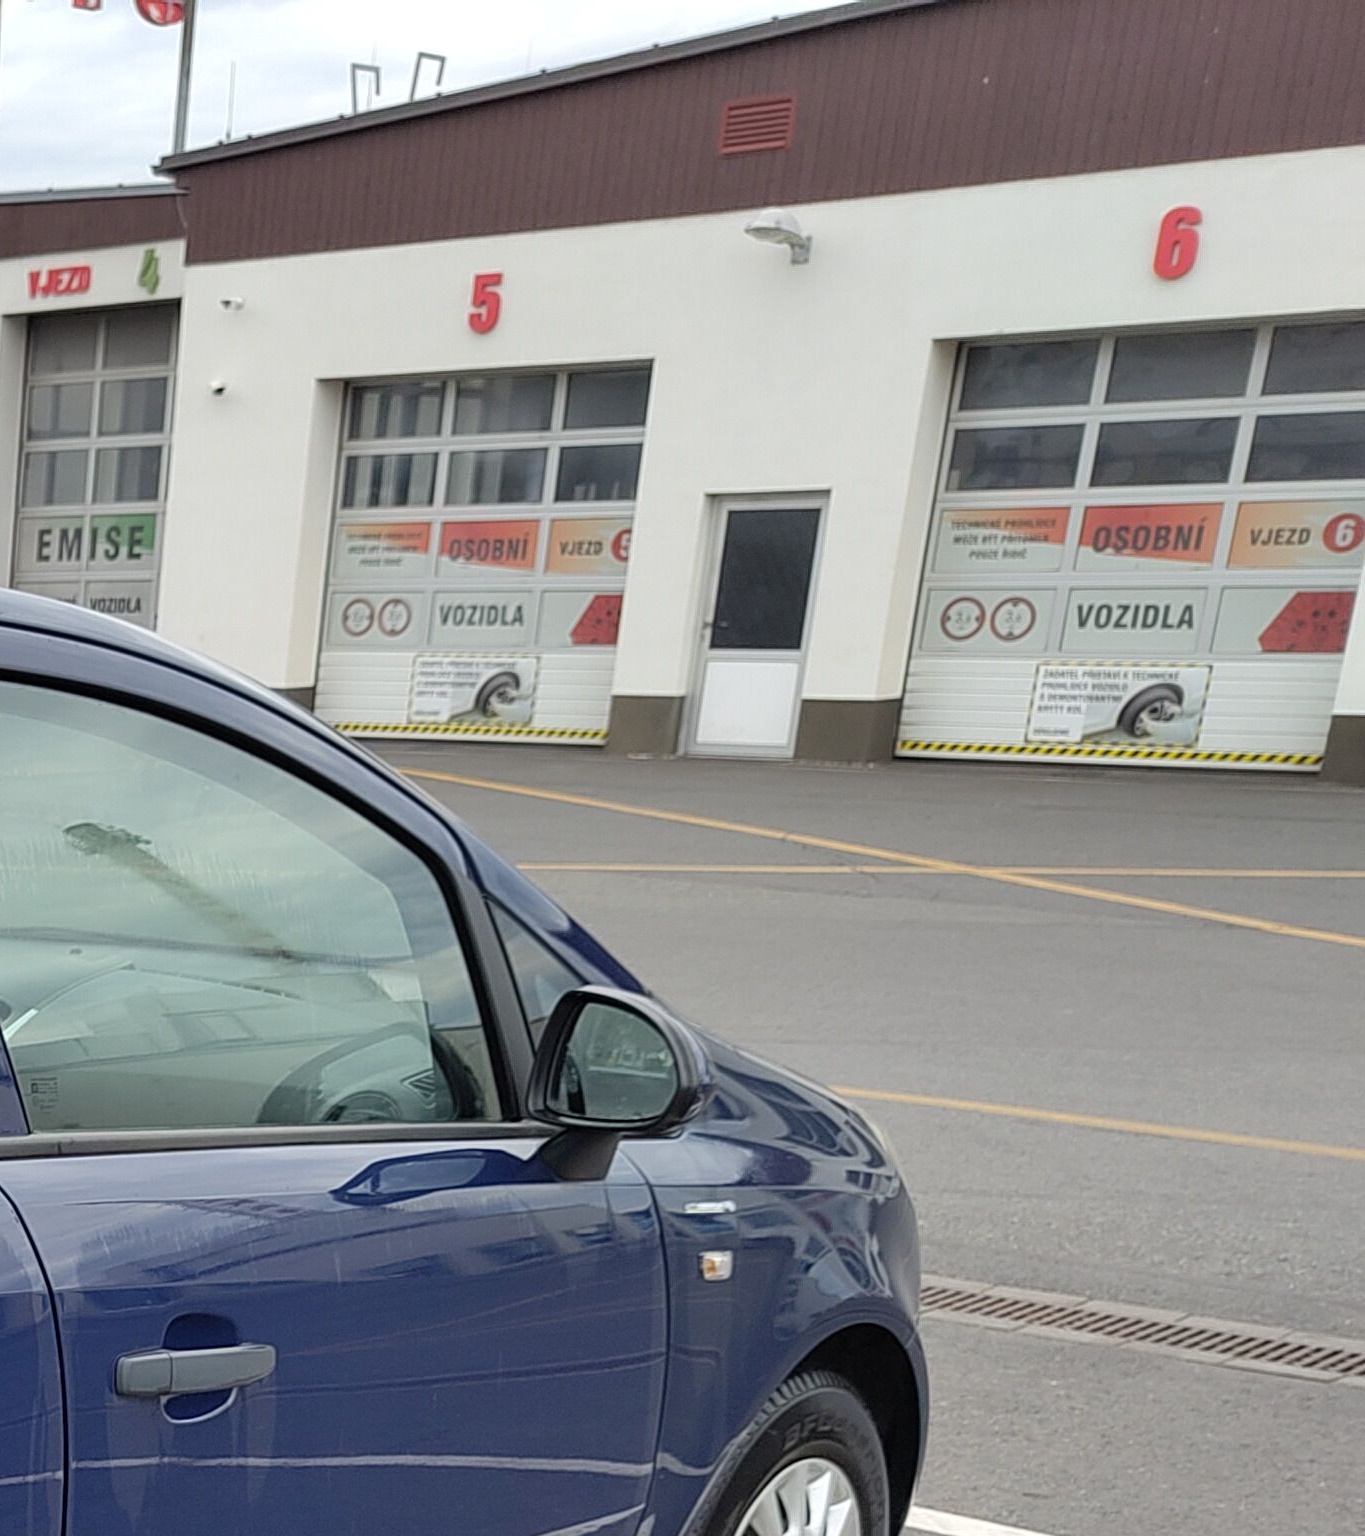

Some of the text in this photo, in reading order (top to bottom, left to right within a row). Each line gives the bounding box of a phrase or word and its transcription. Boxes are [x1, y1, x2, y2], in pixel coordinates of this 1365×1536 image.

[1153, 206, 1203, 280] 6
[27, 248, 160, 299] VJEZD 4
[468, 272, 503, 334] 5
[36, 526, 144, 562] EMISE
[448, 532, 529, 562] OSOBNÍ
[559, 539, 604, 557] VJEZD
[1091, 518, 1209, 553] OSOBNÍ
[1249, 518, 1357, 548] VJEZD 6
[89, 597, 142, 614] VOZIDLA
[439, 604, 525, 628] VOZIDLA
[1077, 603, 1195, 630] VOZIDLA
